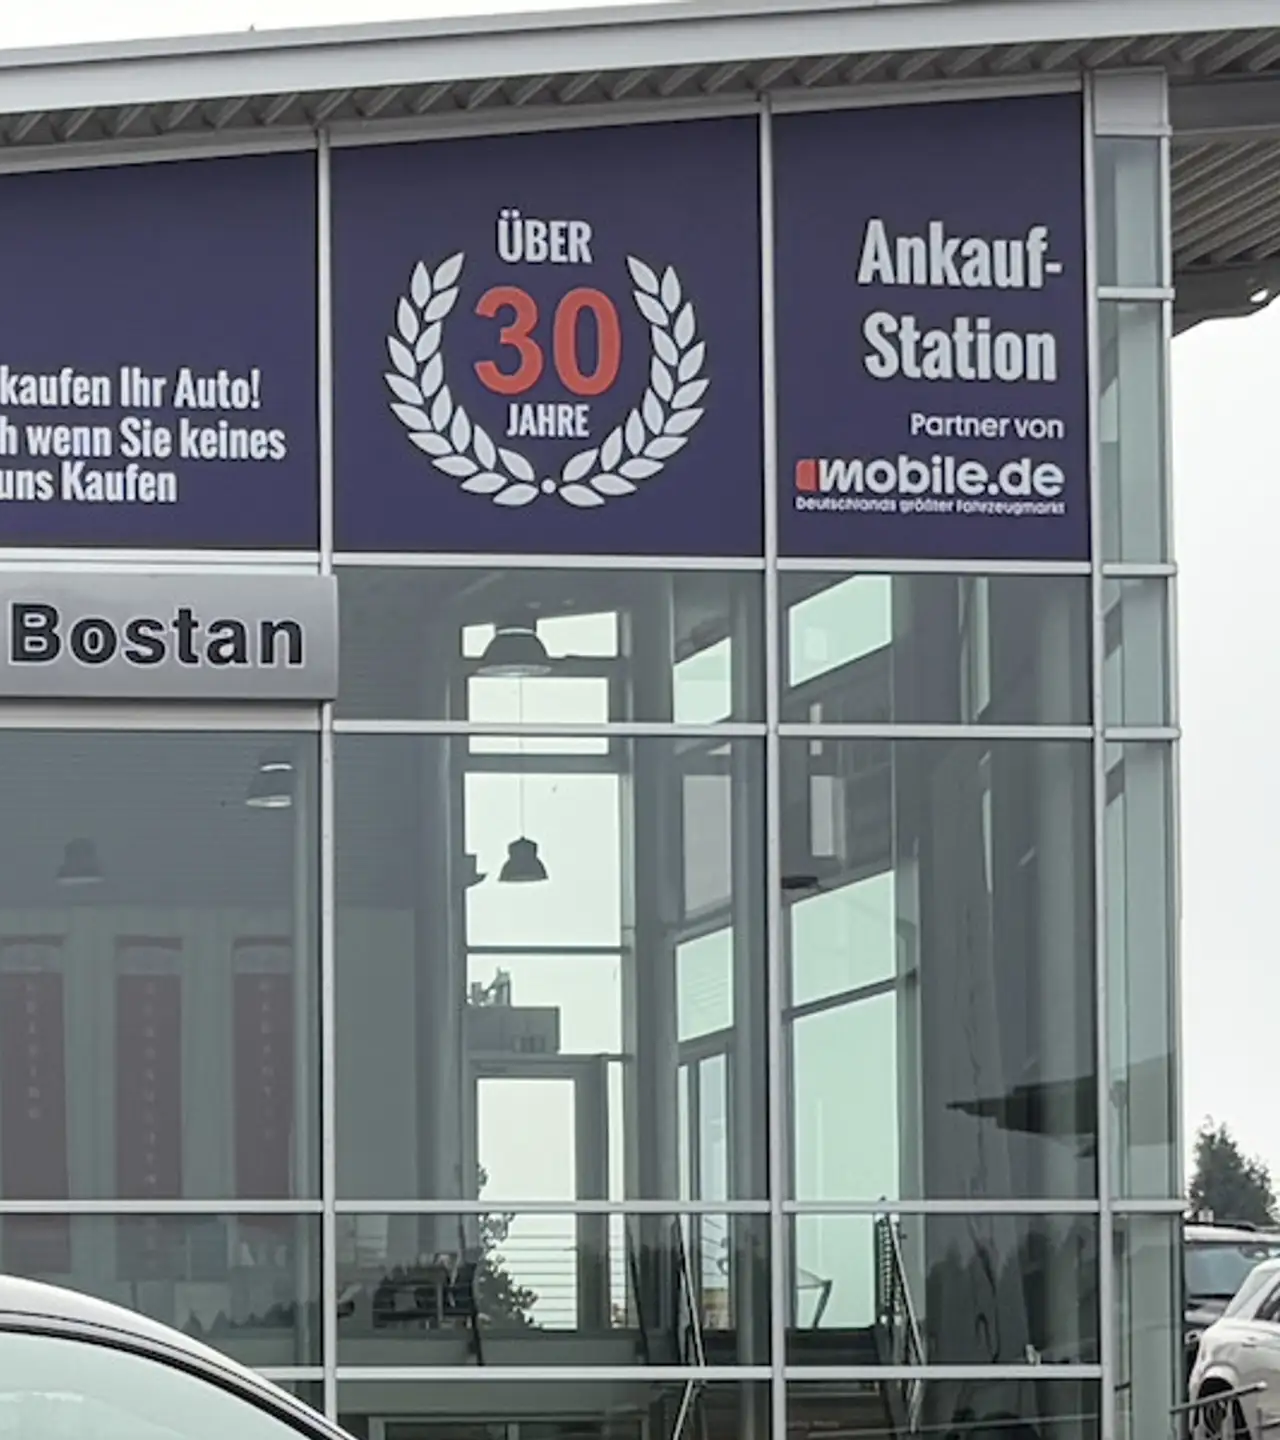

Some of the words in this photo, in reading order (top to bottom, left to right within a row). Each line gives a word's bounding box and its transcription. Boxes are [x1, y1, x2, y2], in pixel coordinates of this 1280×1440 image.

[498, 209, 592, 264] ÜBER
[857, 218, 1064, 289] Ankauf-
[474, 285, 622, 396] 30
[863, 311, 1058, 382] Station
[120, 367, 167, 408] Ihr
[174, 368, 261, 409] Auto!
[25, 424, 113, 457] wenn
[120, 417, 172, 459] Sie
[179, 417, 288, 460] keines
[506, 403, 590, 438] JAHRE
[910, 412, 1010, 438] Partner
[1014, 417, 1065, 439] von
[61, 460, 178, 503] Kaufen
[818, 455, 1065, 497] mobile.de
[796, 496, 897, 512] Deutschlands
[9, 602, 306, 668] Bostan
